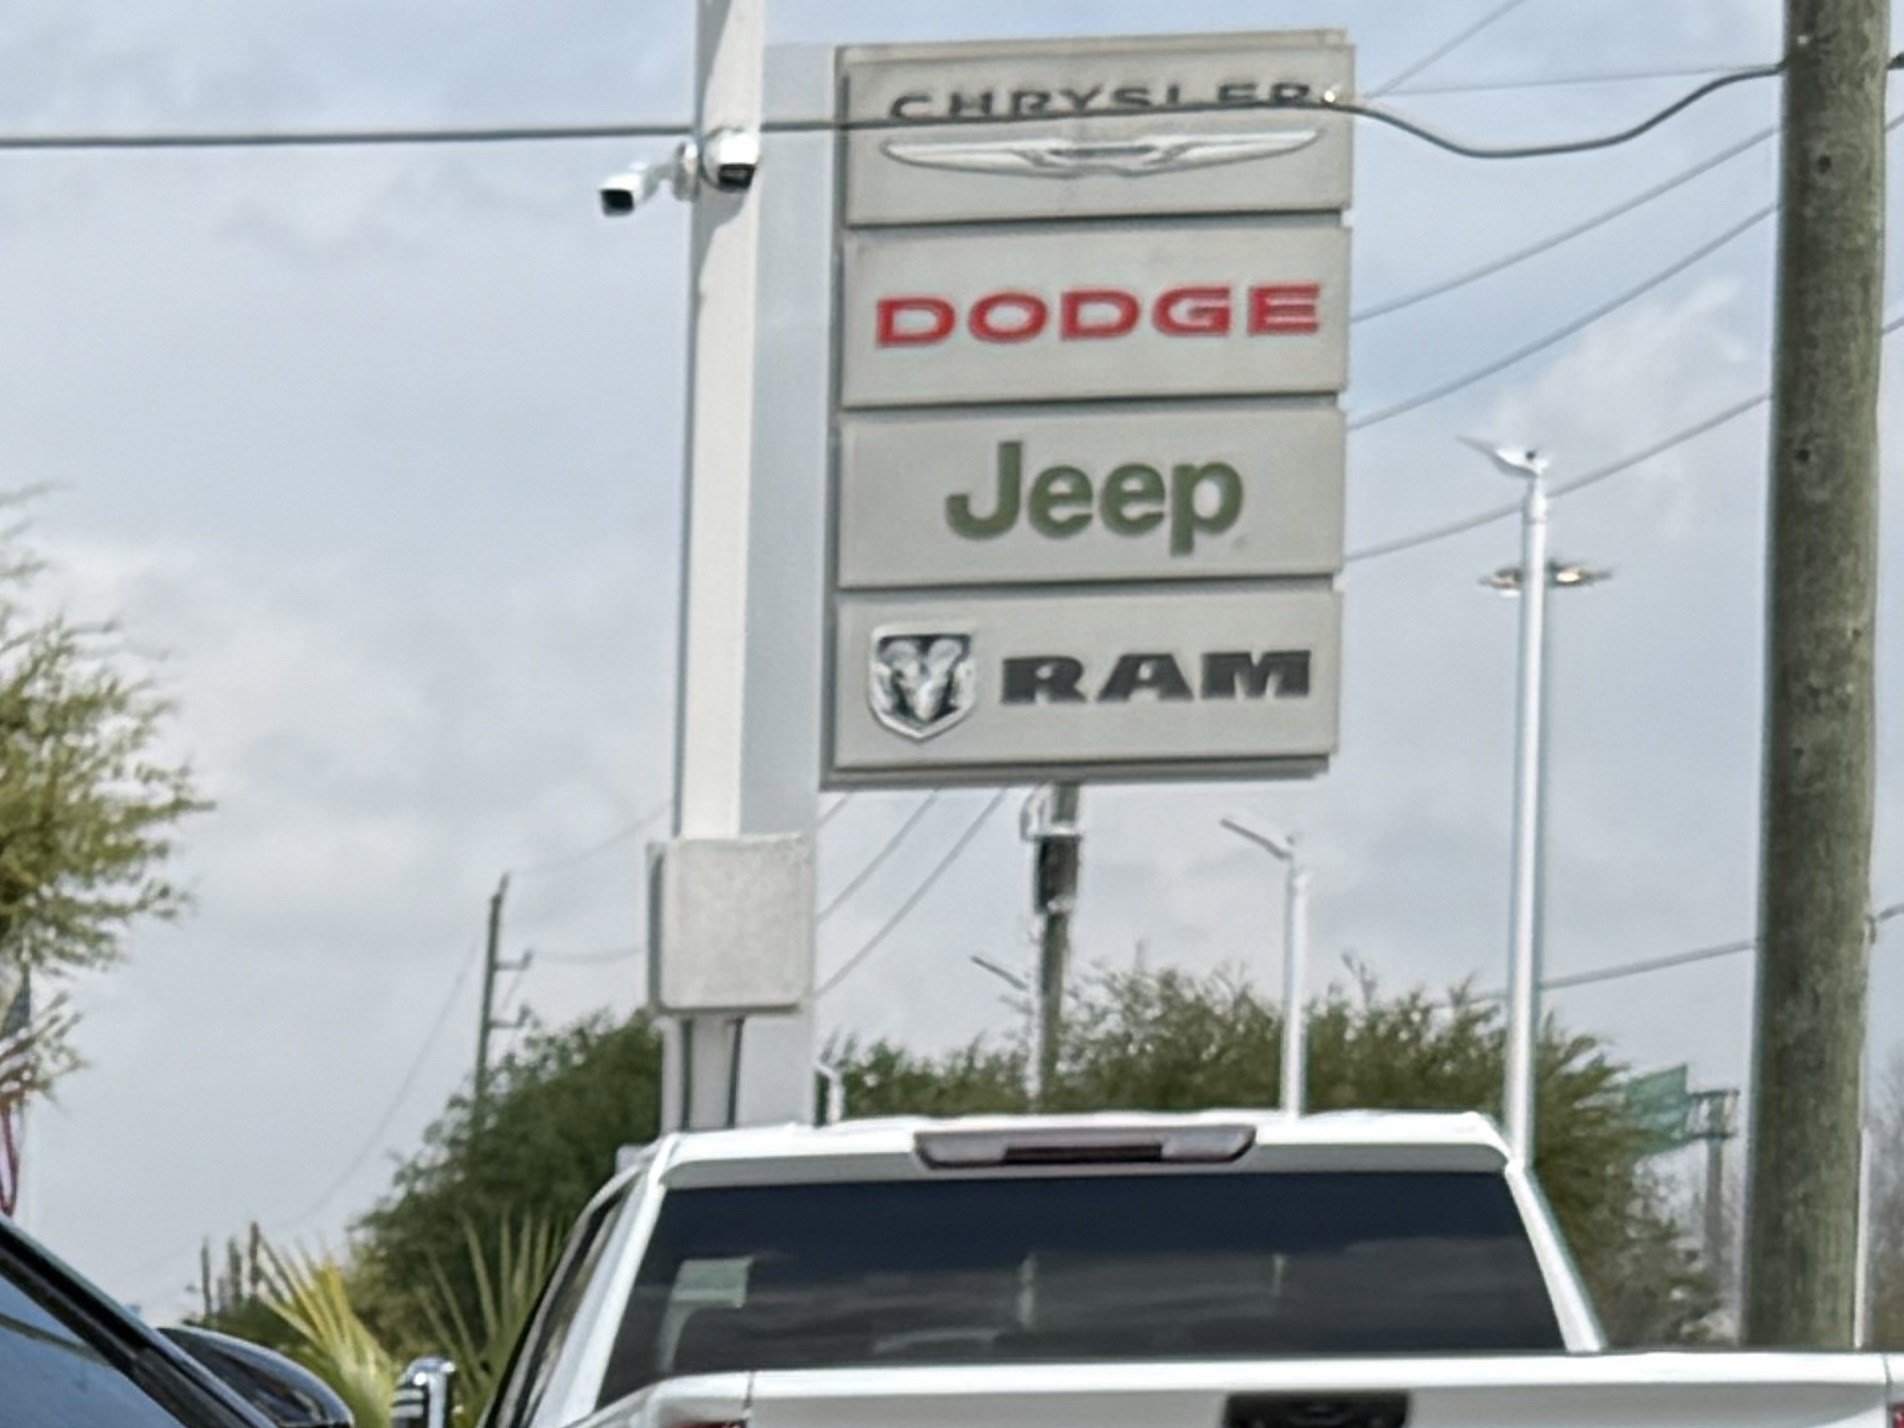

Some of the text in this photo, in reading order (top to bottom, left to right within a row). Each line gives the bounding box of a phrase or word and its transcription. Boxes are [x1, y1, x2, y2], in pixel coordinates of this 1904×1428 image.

[876, 284, 1320, 348] DODGE
[945, 440, 1244, 557] Jeep
[999, 650, 1311, 704] RAM
